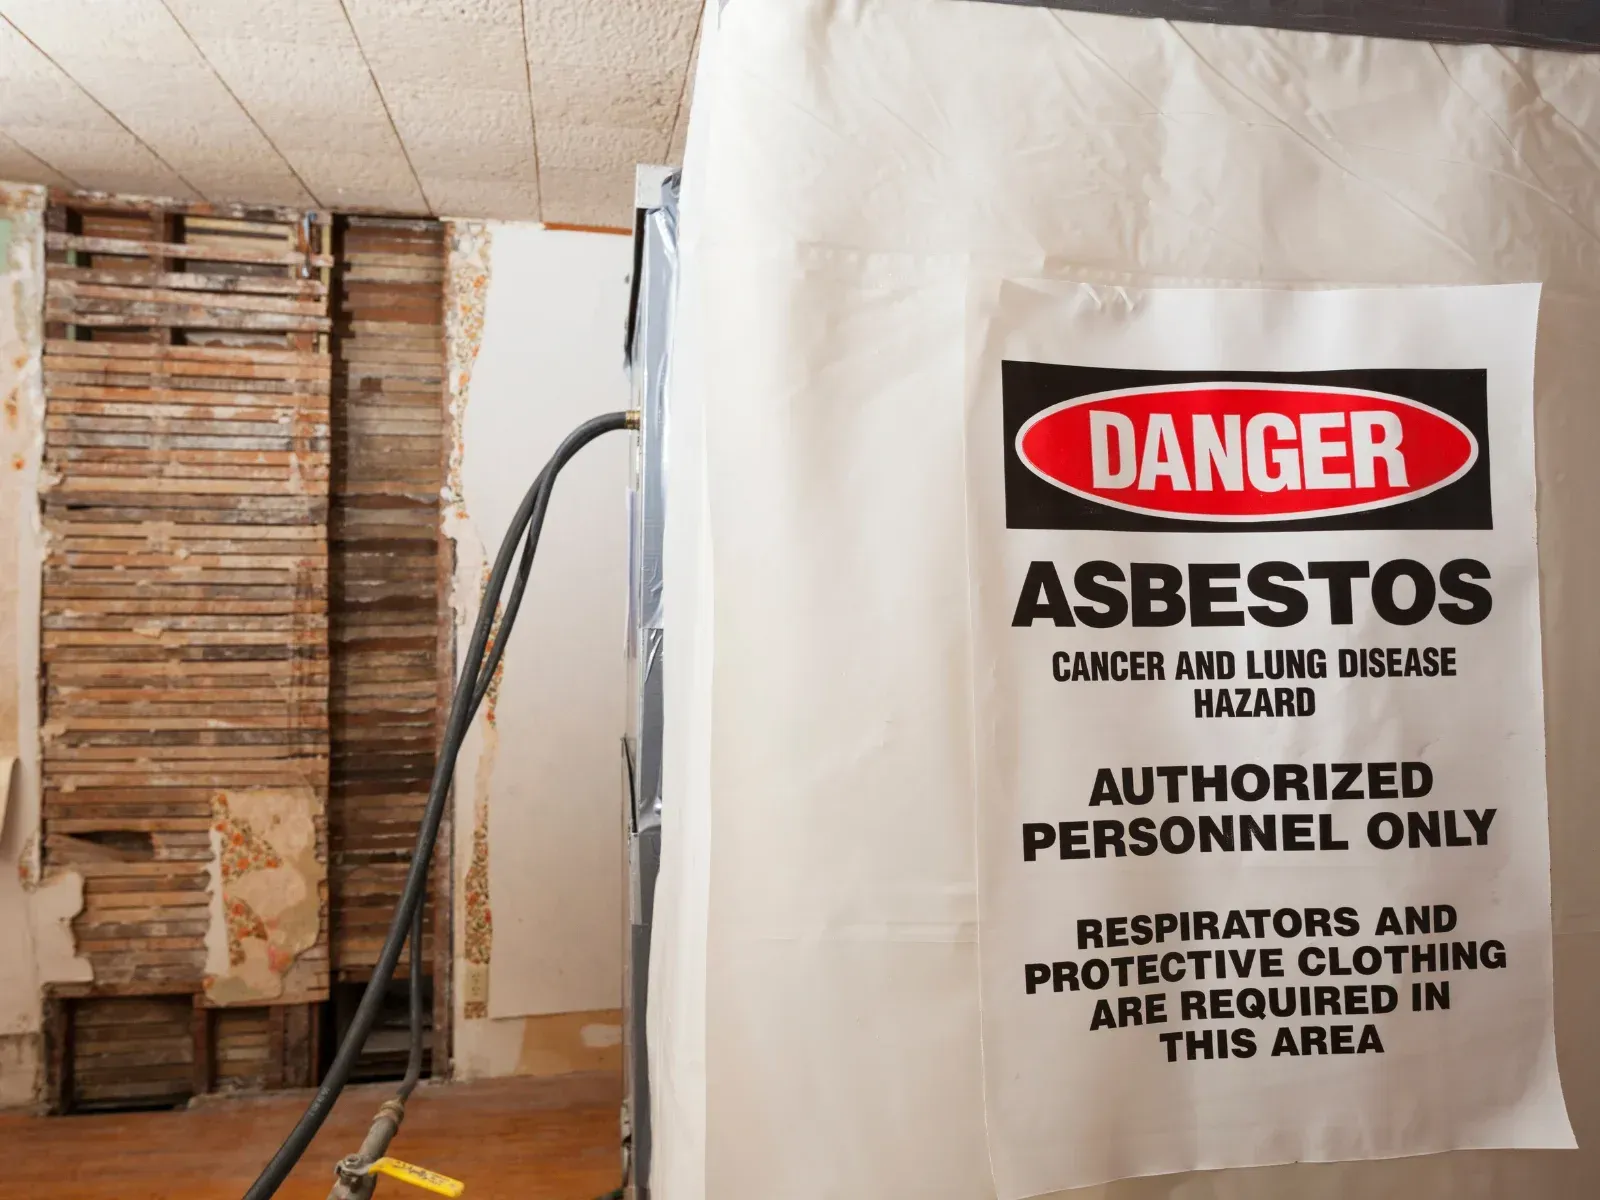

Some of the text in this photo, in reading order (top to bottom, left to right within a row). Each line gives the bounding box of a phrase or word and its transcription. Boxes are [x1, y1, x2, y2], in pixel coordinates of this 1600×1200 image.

[1089, 409, 1410, 493] DANGER
[1012, 558, 1493, 628] ASBESTOS
[1053, 646, 1457, 682] CANCER AND LUNG DISEASE
[1194, 686, 1316, 718] HAZARD
[1089, 761, 1434, 807] AUTHORIZED
[1023, 808, 1498, 862] PERSONNEL ONLY
[1077, 903, 1458, 950] RESPIRATORS AND
[1025, 939, 1507, 995] PROTECTIVE CLOTHING
[1090, 980, 1451, 1032] ARE REQUIRED IN
[1159, 1023, 1386, 1063] THIS AREA
